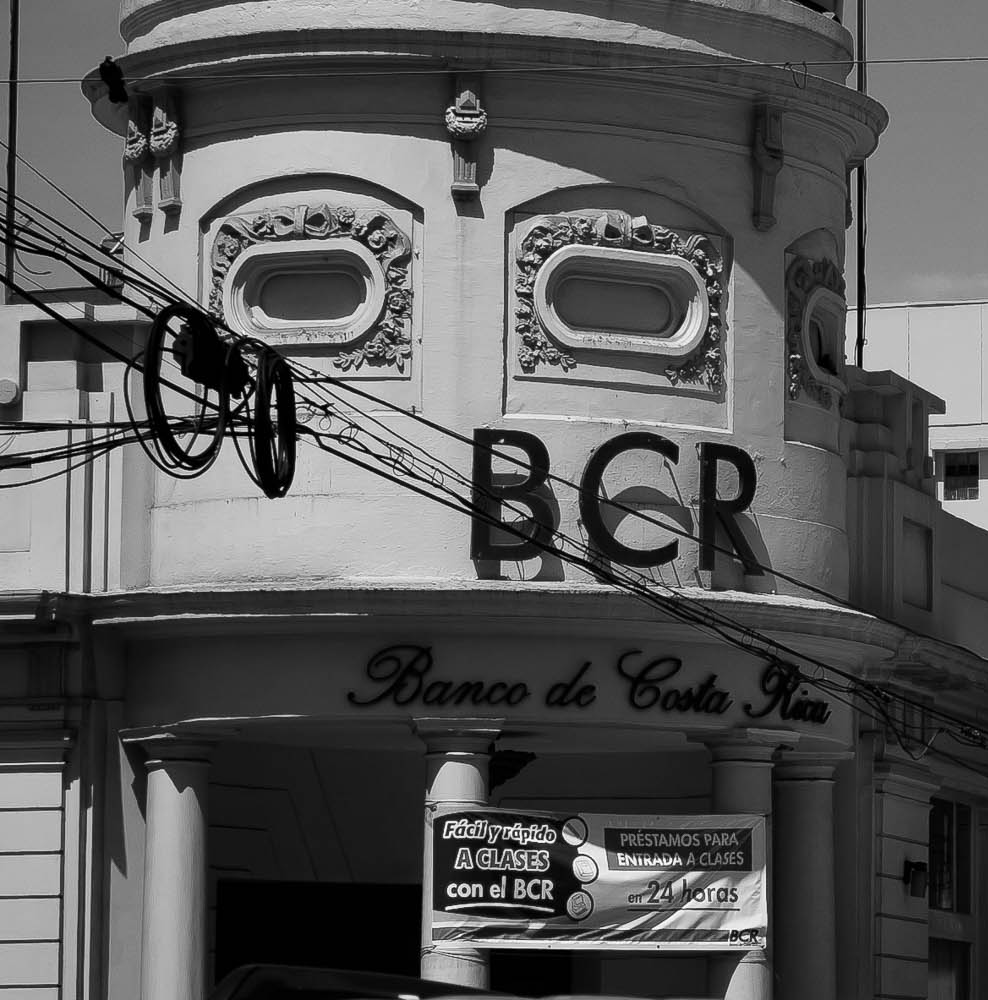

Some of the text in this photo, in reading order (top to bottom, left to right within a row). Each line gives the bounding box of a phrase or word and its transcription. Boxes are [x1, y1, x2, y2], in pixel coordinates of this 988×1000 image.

[470, 428, 765, 577] BCR
[347, 645, 832, 724] Banco de Costa Rica
[443, 819, 557, 845] Fácil y rápido
[620, 830, 739, 847] PRÉSTAMOS PARA
[454, 848, 550, 872] A CLASES
[617, 851, 744, 867] ENTRADA A CLASES
[446, 875, 554, 900] con el BCR
[627, 878, 739, 904] en 24 horas
[729, 928, 759, 944] BCR
